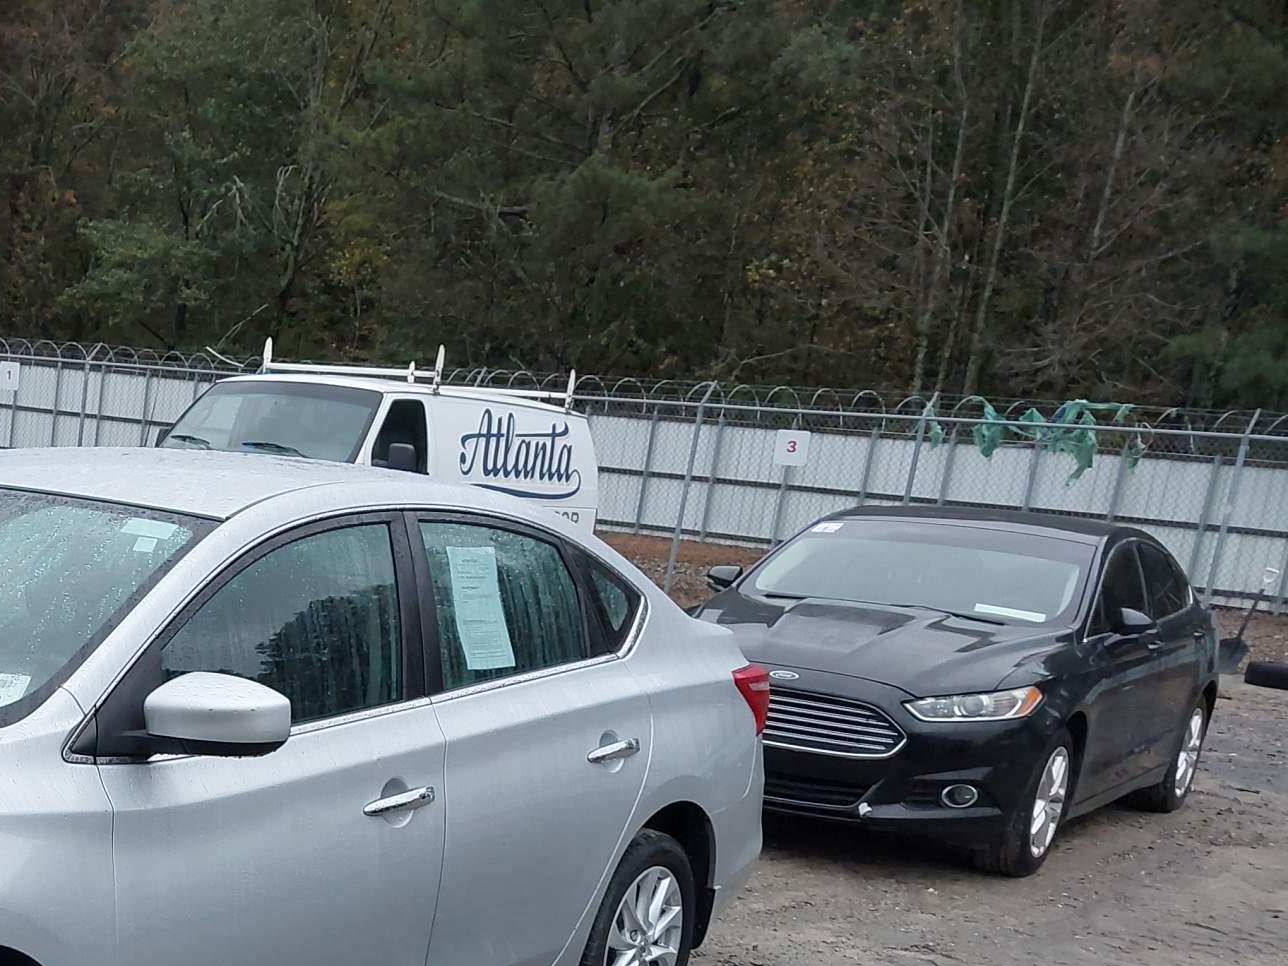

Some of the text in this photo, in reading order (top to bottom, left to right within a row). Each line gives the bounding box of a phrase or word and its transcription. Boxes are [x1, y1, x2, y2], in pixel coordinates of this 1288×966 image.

[7, 370, 12, 380] 1
[459, 407, 581, 499] Atlanta
[786, 440, 797, 453] 3
